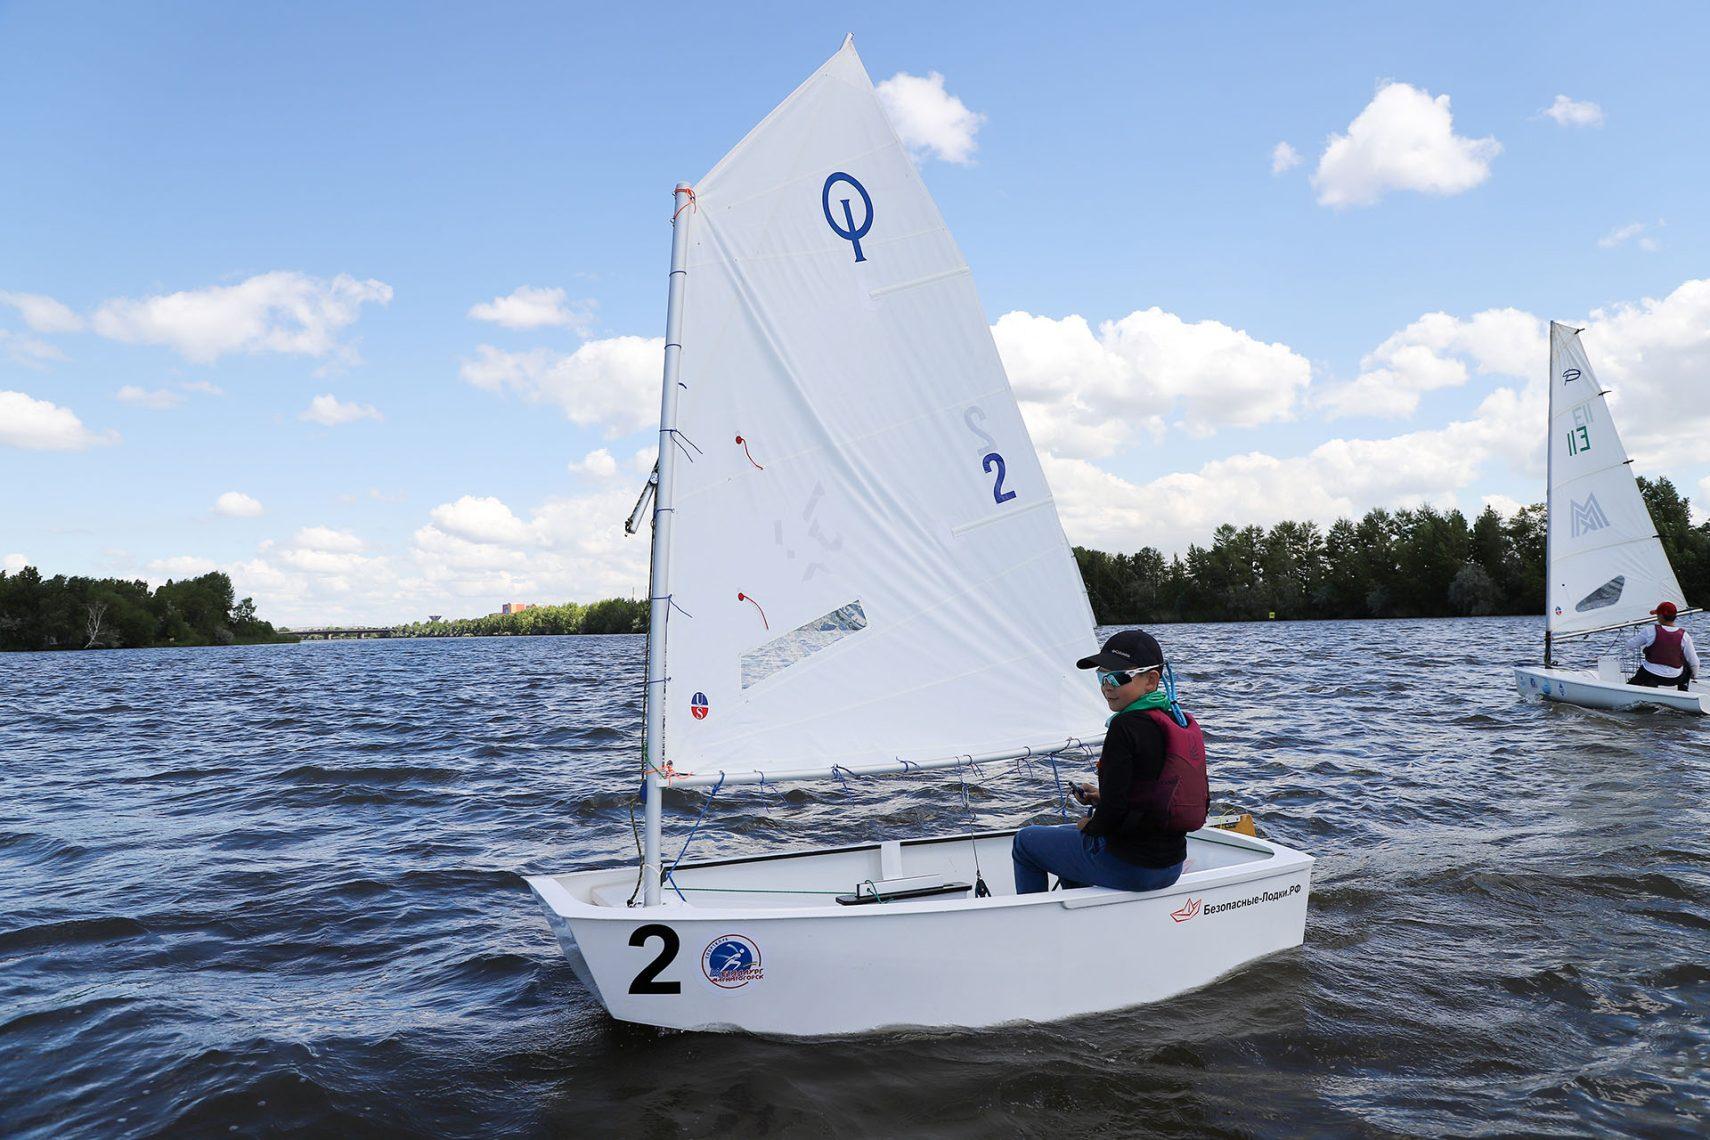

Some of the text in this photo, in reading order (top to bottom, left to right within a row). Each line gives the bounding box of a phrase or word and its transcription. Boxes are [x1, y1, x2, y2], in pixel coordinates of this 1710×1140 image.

[982, 452, 1017, 504] 2
[1203, 883, 1302, 916] Безопасные-Лодки.РФ
[628, 923, 681, 995] 2
